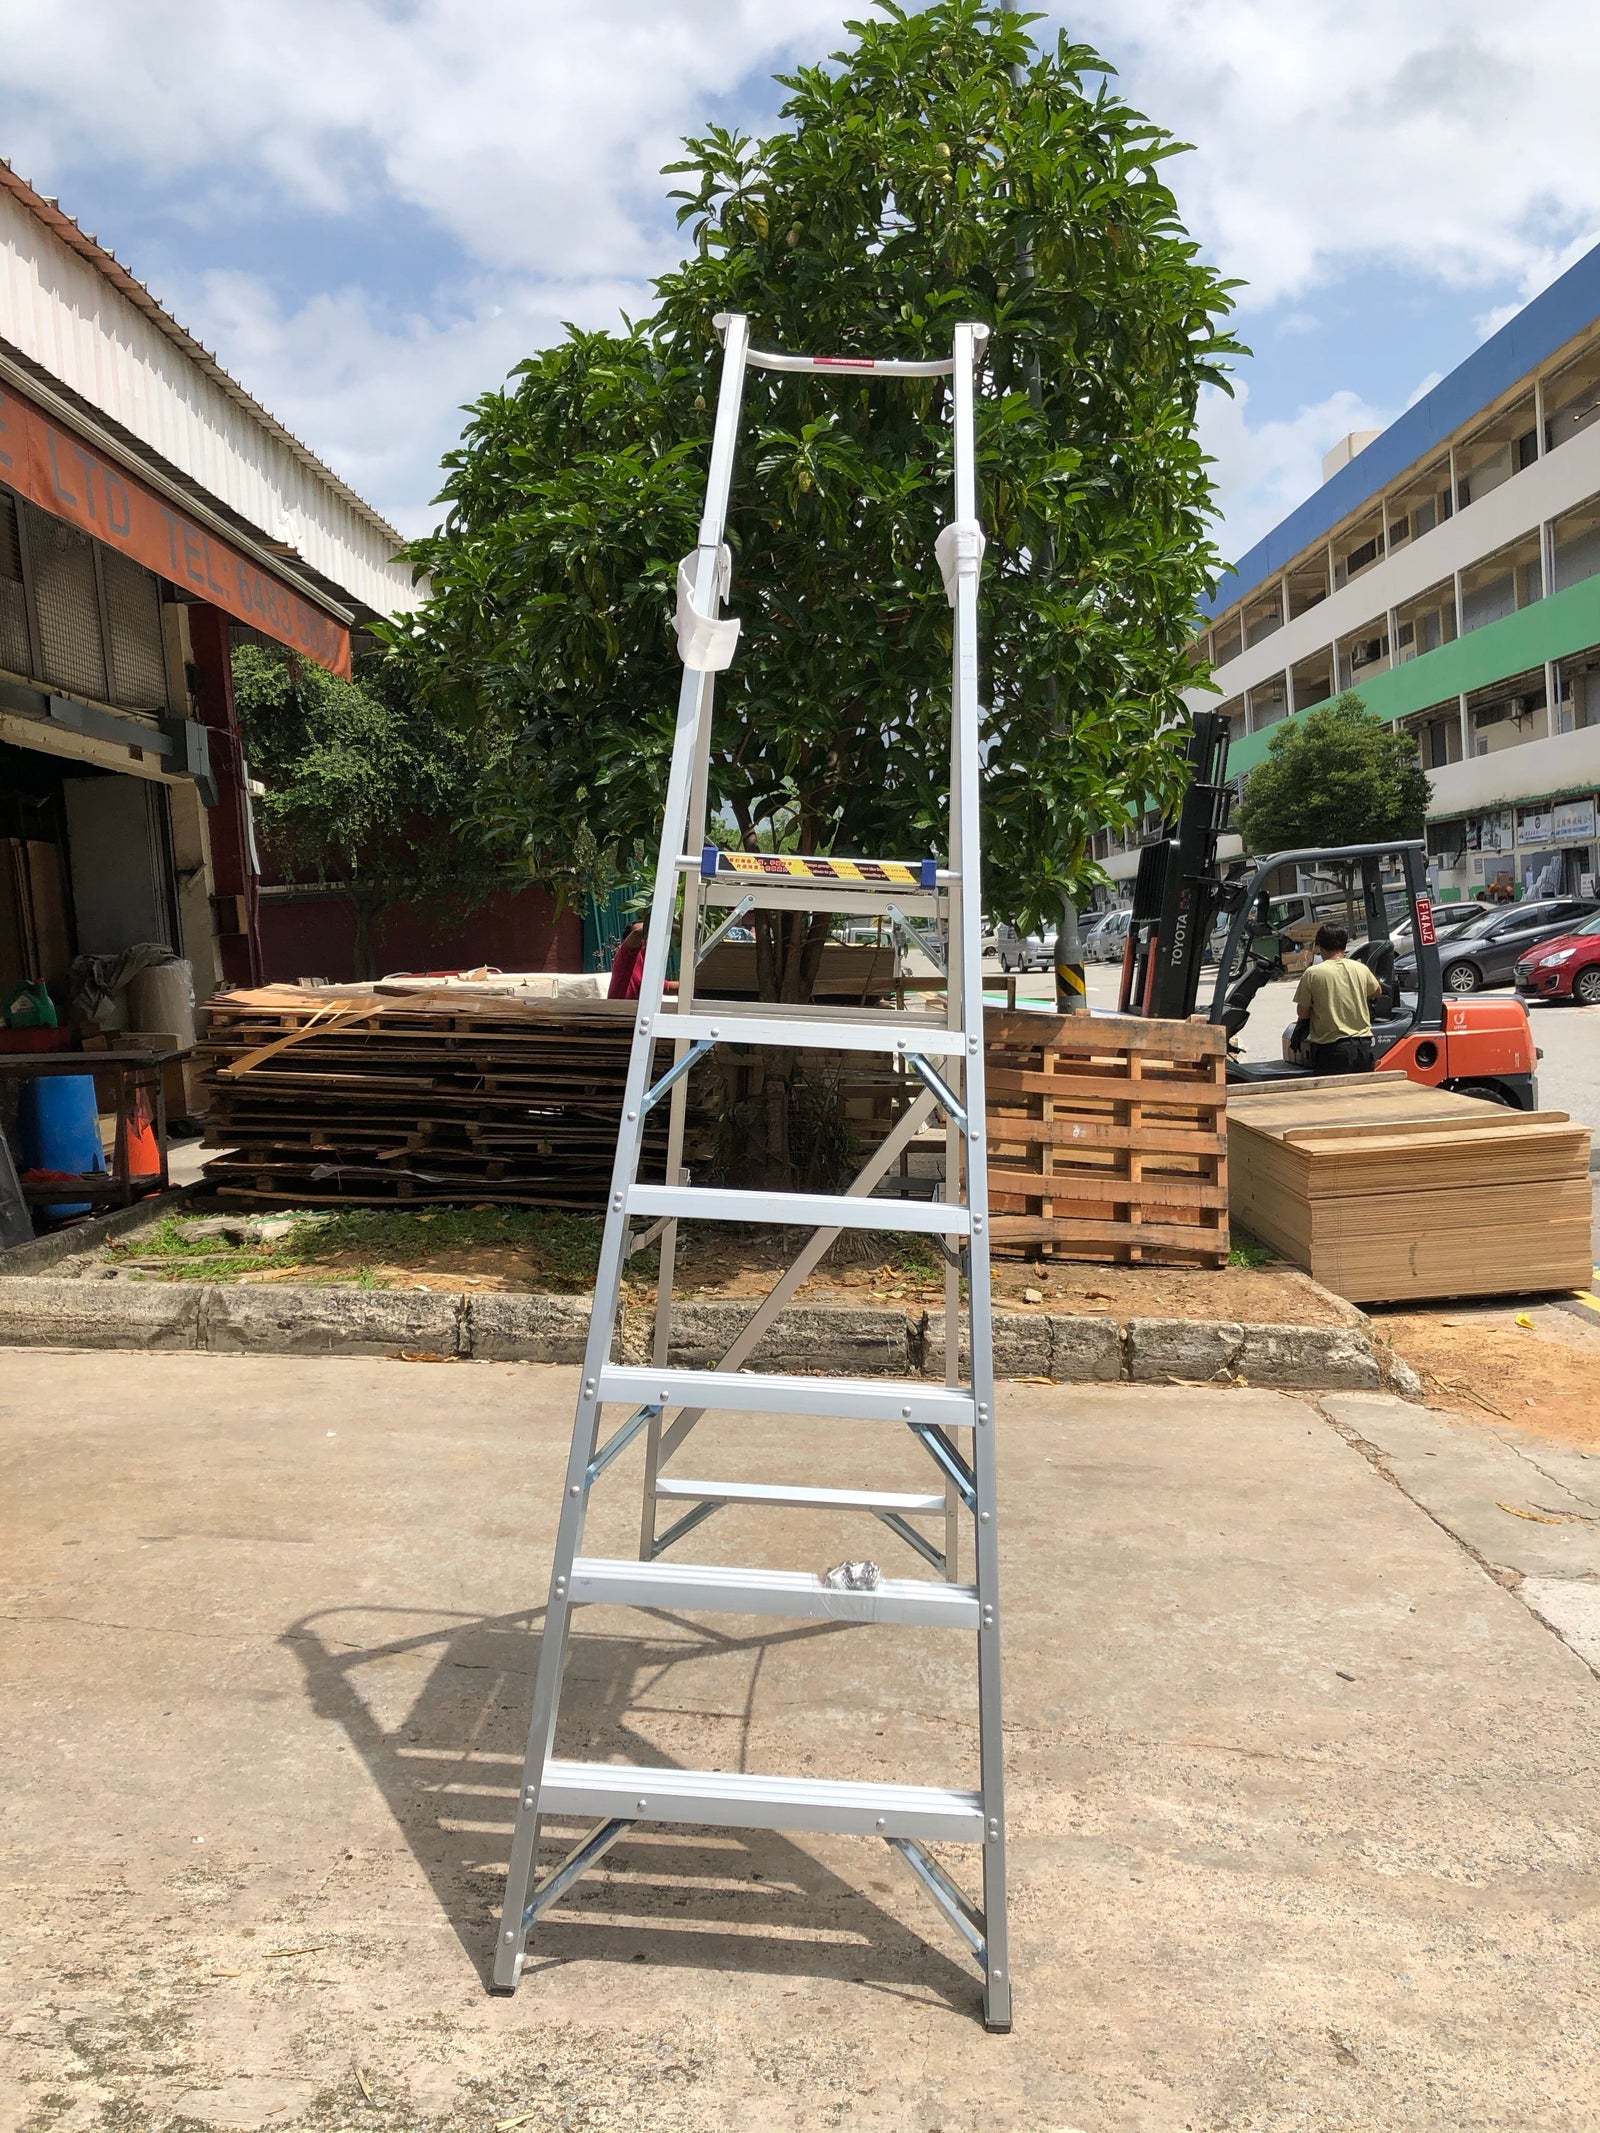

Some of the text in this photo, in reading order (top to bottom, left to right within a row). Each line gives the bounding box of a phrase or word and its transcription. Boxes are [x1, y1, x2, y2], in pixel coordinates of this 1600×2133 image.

[47, 425, 131, 538] LTD
[1170, 914, 1188, 967] TOYOTA
[1418, 903, 1434, 942] F14AJZ
